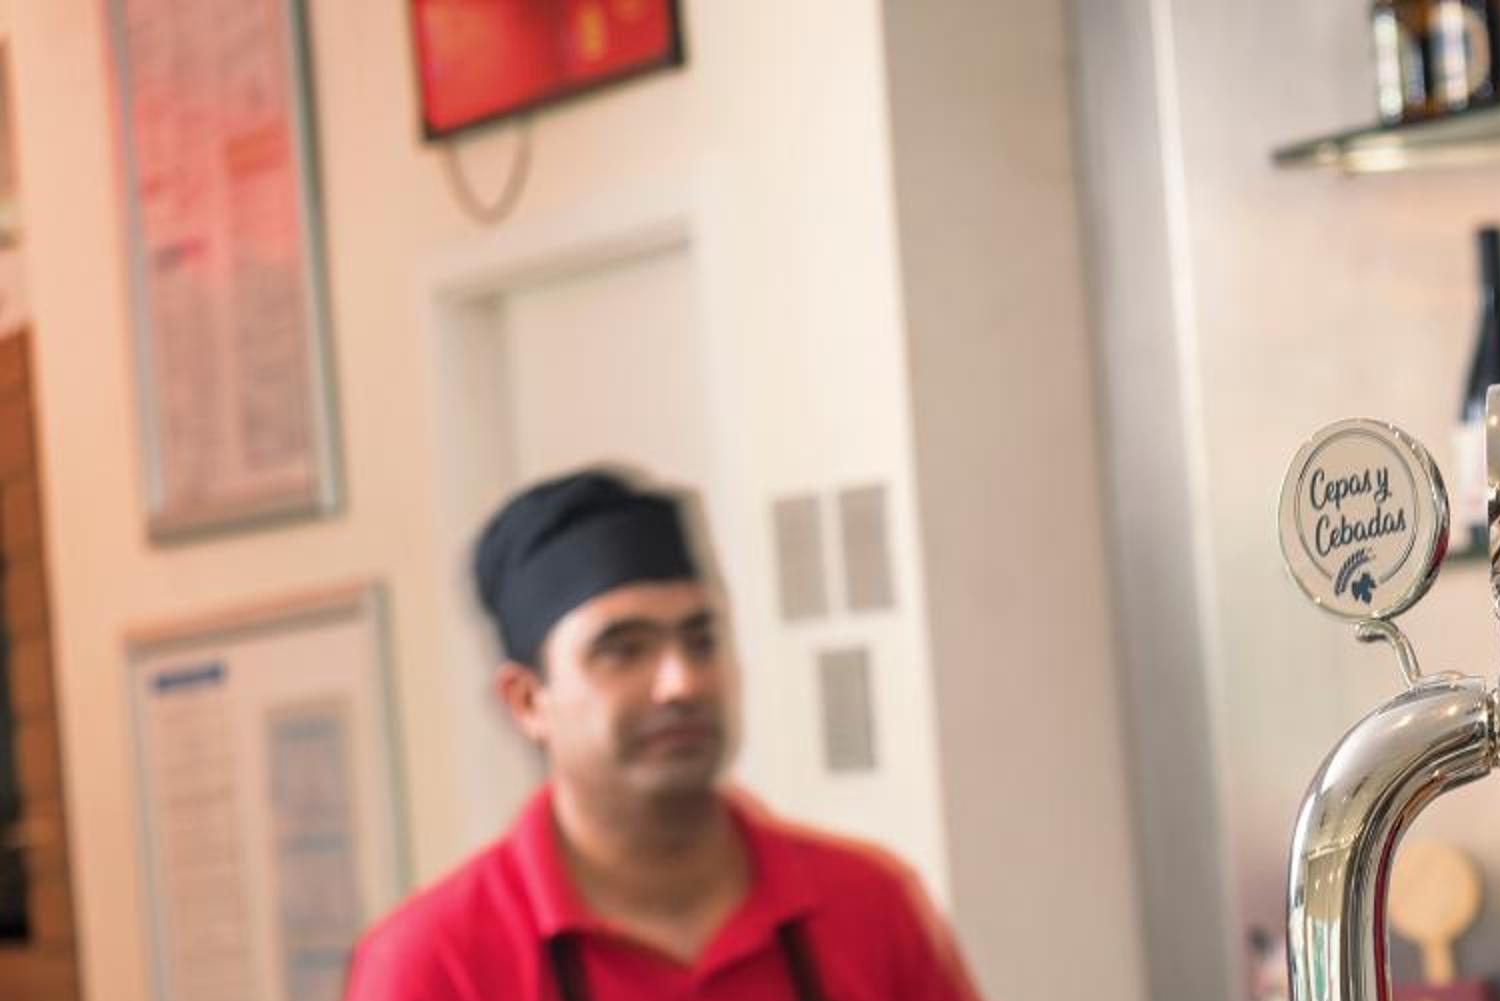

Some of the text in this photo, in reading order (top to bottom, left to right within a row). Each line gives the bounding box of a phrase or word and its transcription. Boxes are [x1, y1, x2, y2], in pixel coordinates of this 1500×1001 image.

[1310, 466, 1392, 511] Cepas y
[1315, 506, 1407, 558] Cebadas
